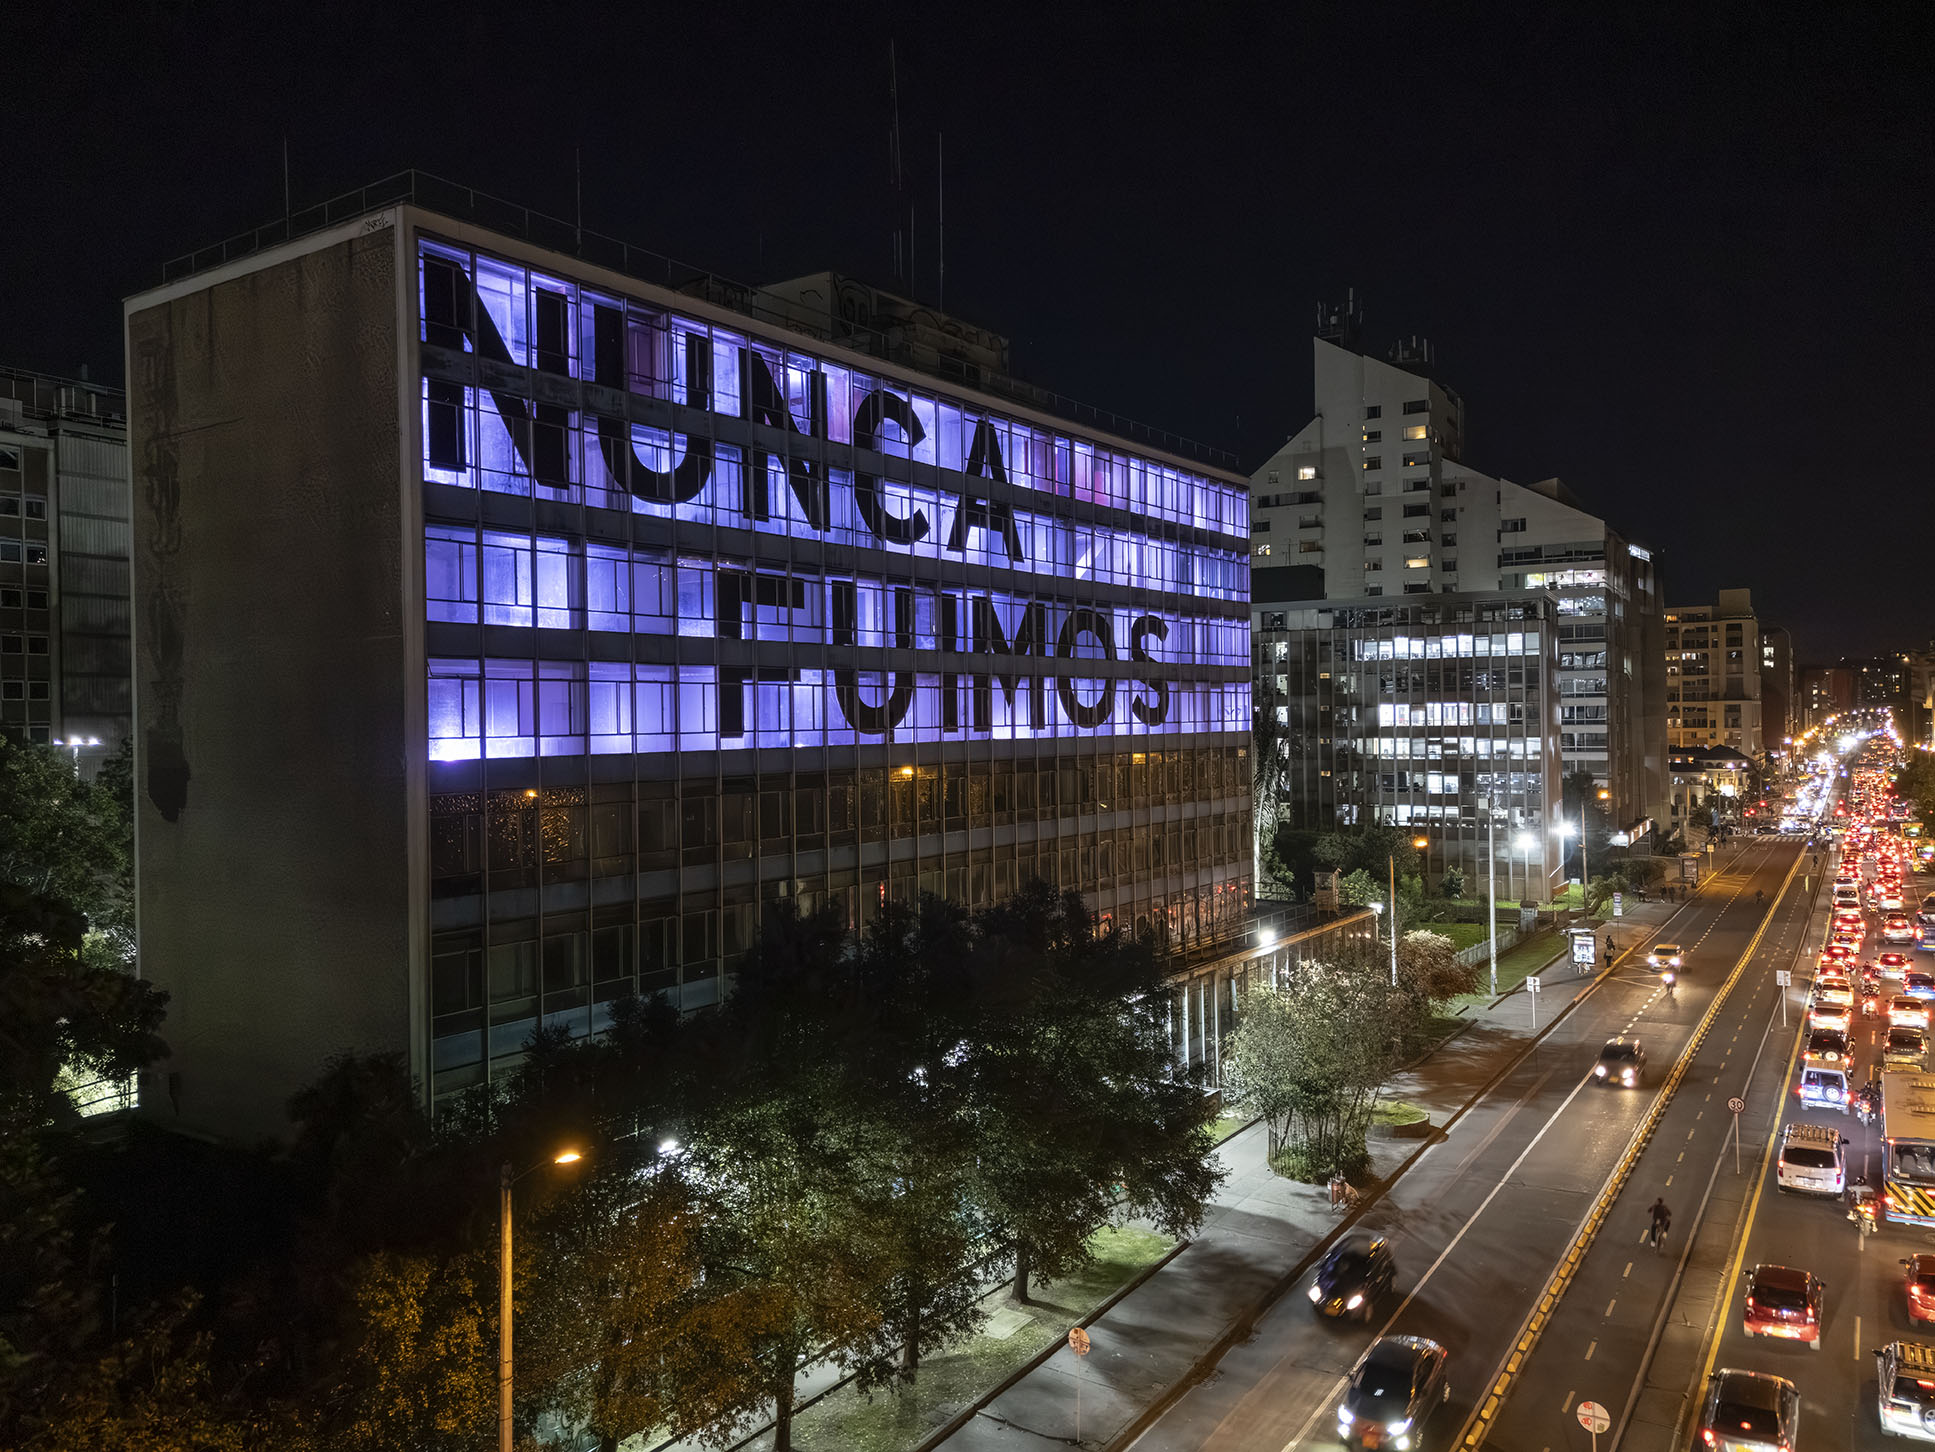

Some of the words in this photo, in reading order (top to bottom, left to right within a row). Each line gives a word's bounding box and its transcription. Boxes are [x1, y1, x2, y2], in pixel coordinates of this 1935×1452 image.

[422, 254, 1026, 562] NUNCA
[717, 568, 1169, 738] FUIMOS
[1730, 1100, 1743, 1110] 30
